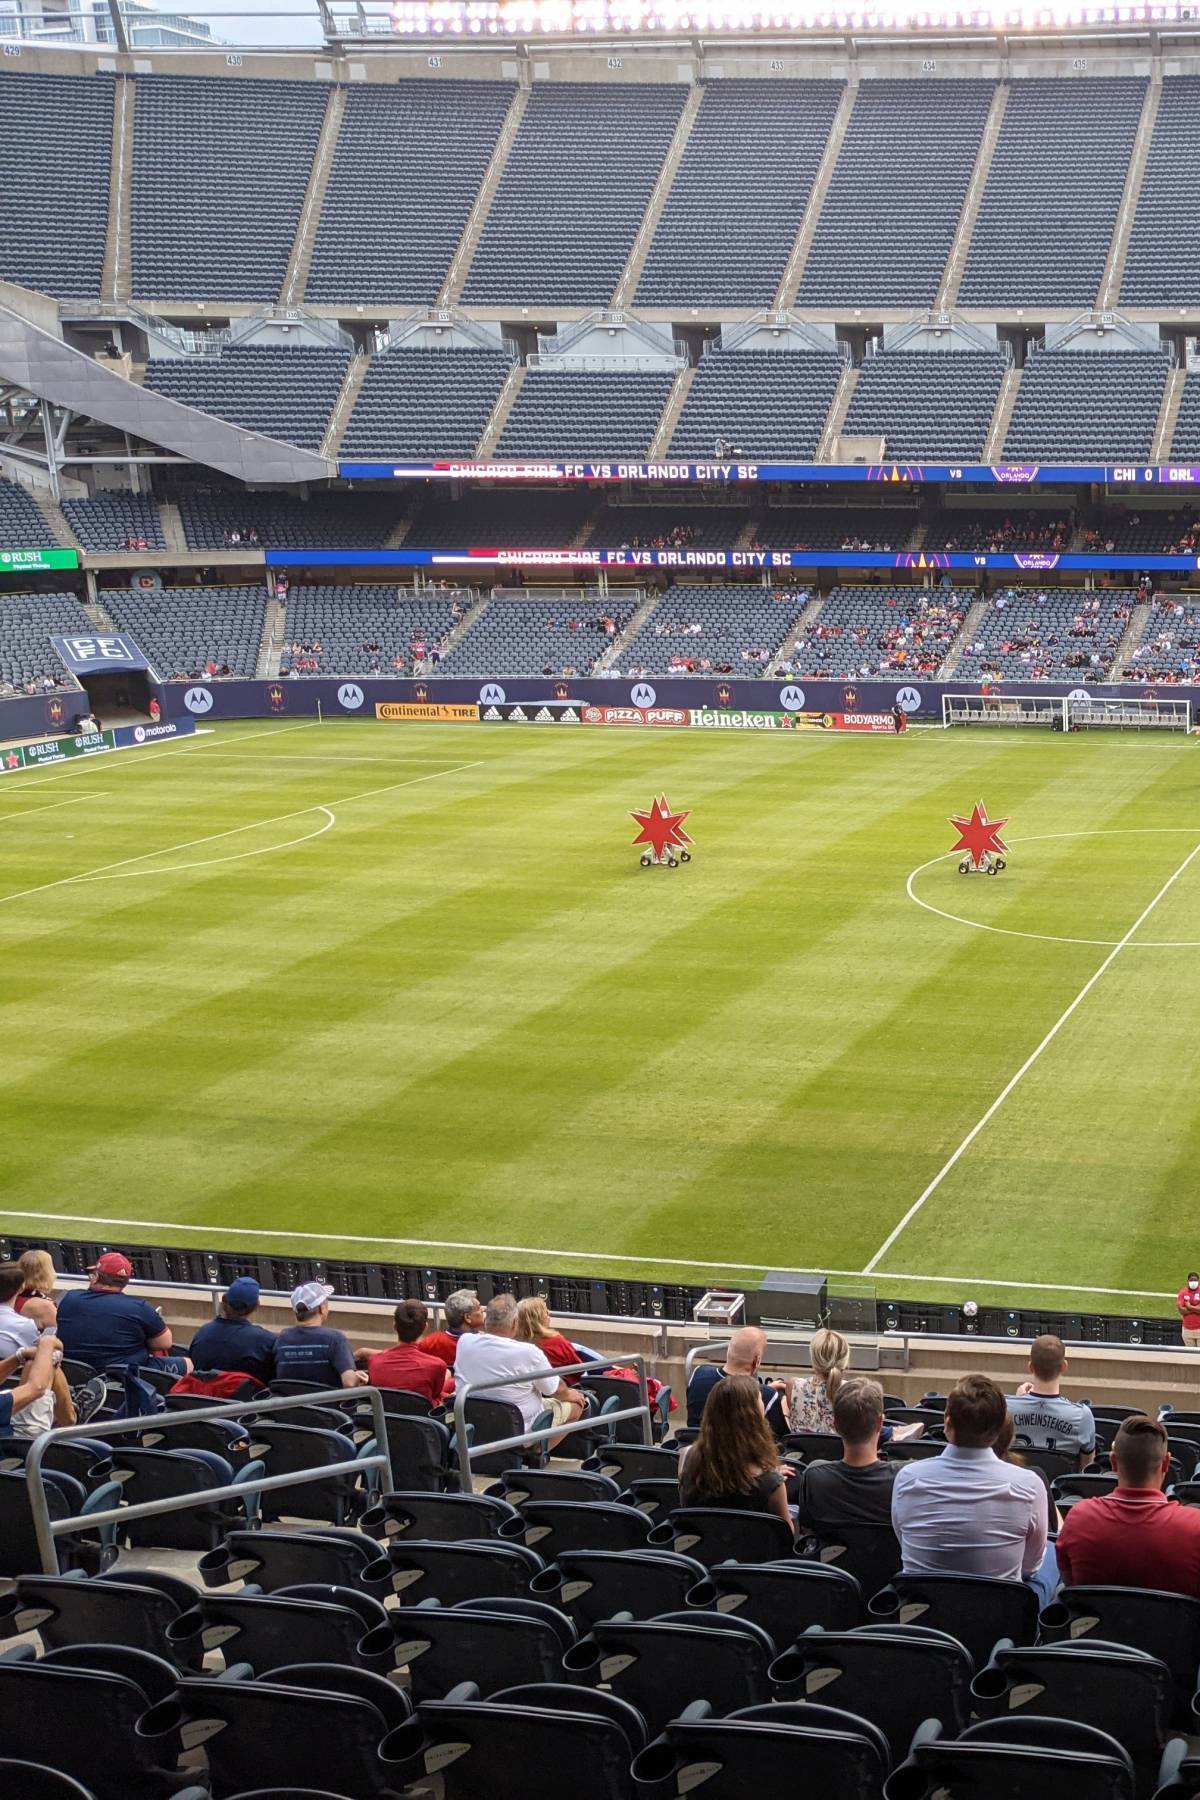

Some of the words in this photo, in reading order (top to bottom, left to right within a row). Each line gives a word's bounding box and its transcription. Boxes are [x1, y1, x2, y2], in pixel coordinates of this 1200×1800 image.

[4, 46, 20, 56] 429
[227, 54, 242, 66] 430
[428, 56, 442, 67] 431
[608, 58, 622, 68] 432
[770, 60, 785, 71] 433
[922, 60, 936, 71] 434
[1073, 58, 1087, 70] 435
[564, 464, 584, 478] FC
[590, 465, 611, 479] VS
[618, 465, 689, 480] ORLANDO
[696, 466, 730, 480] CITY
[738, 466, 758, 480] SC
[950, 470, 962, 478] VS
[1114, 469, 1136, 481] CHI
[1144, 469, 1152, 481] 0
[1169, 470, 1194, 481] ORL
[12, 552, 42, 562] RUSH
[606, 552, 626, 564] FC
[632, 552, 652, 565] VS
[658, 552, 726, 566] ORLANDO
[732, 552, 766, 566] CITY
[772, 552, 792, 566] SC
[974, 557, 986, 565] VS
[72, 639, 116, 650] CF
[78, 648, 122, 659] FC
[380, 704, 441, 718] Continental
[452, 708, 476, 718] TIRE
[606, 710, 642, 721] PIZZA
[647, 710, 684, 722] PUFF
[688, 709, 776, 728] Heineken
[844, 714, 894, 725] BODYARMO
[146, 724, 176, 736] motorola
[82, 733, 104, 746] RUSH
[37, 742, 59, 756] RUSH
[1014, 1412, 1073, 1434] CHWEINSTEIGER
